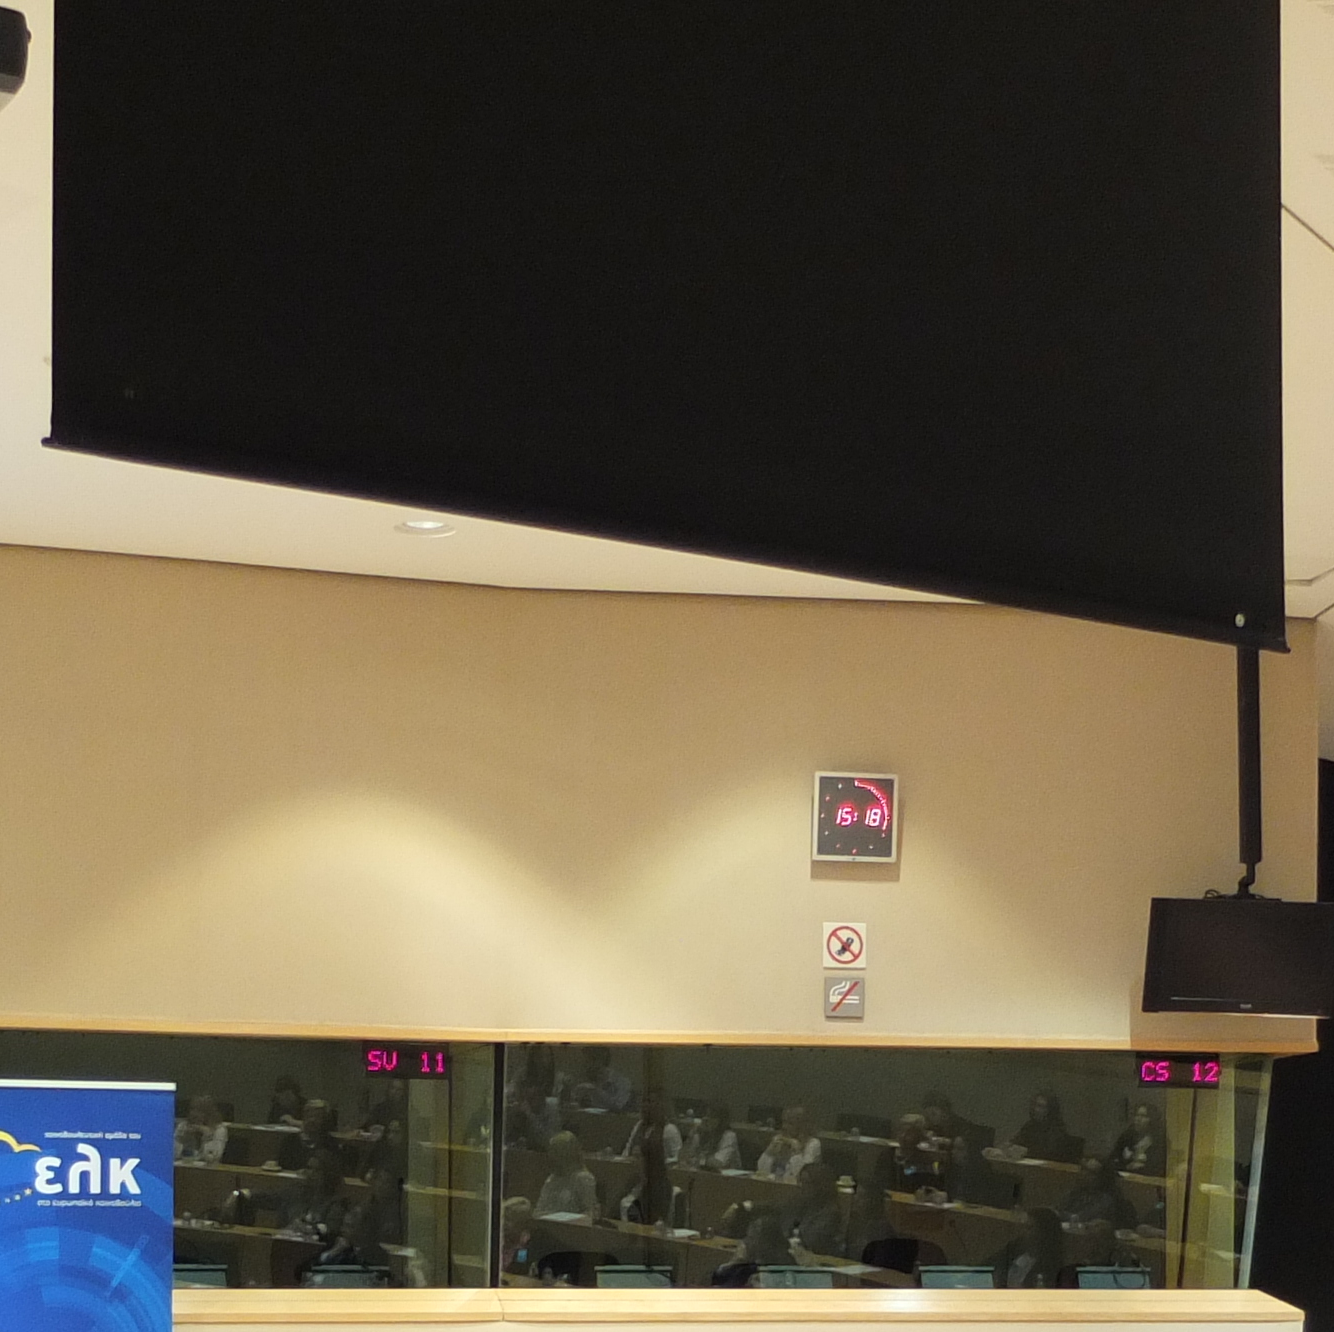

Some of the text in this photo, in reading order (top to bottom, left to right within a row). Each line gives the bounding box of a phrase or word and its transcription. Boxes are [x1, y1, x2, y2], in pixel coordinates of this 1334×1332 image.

[421, 1051, 444, 1073] 11
[1142, 1061, 1219, 1082] CS 12
